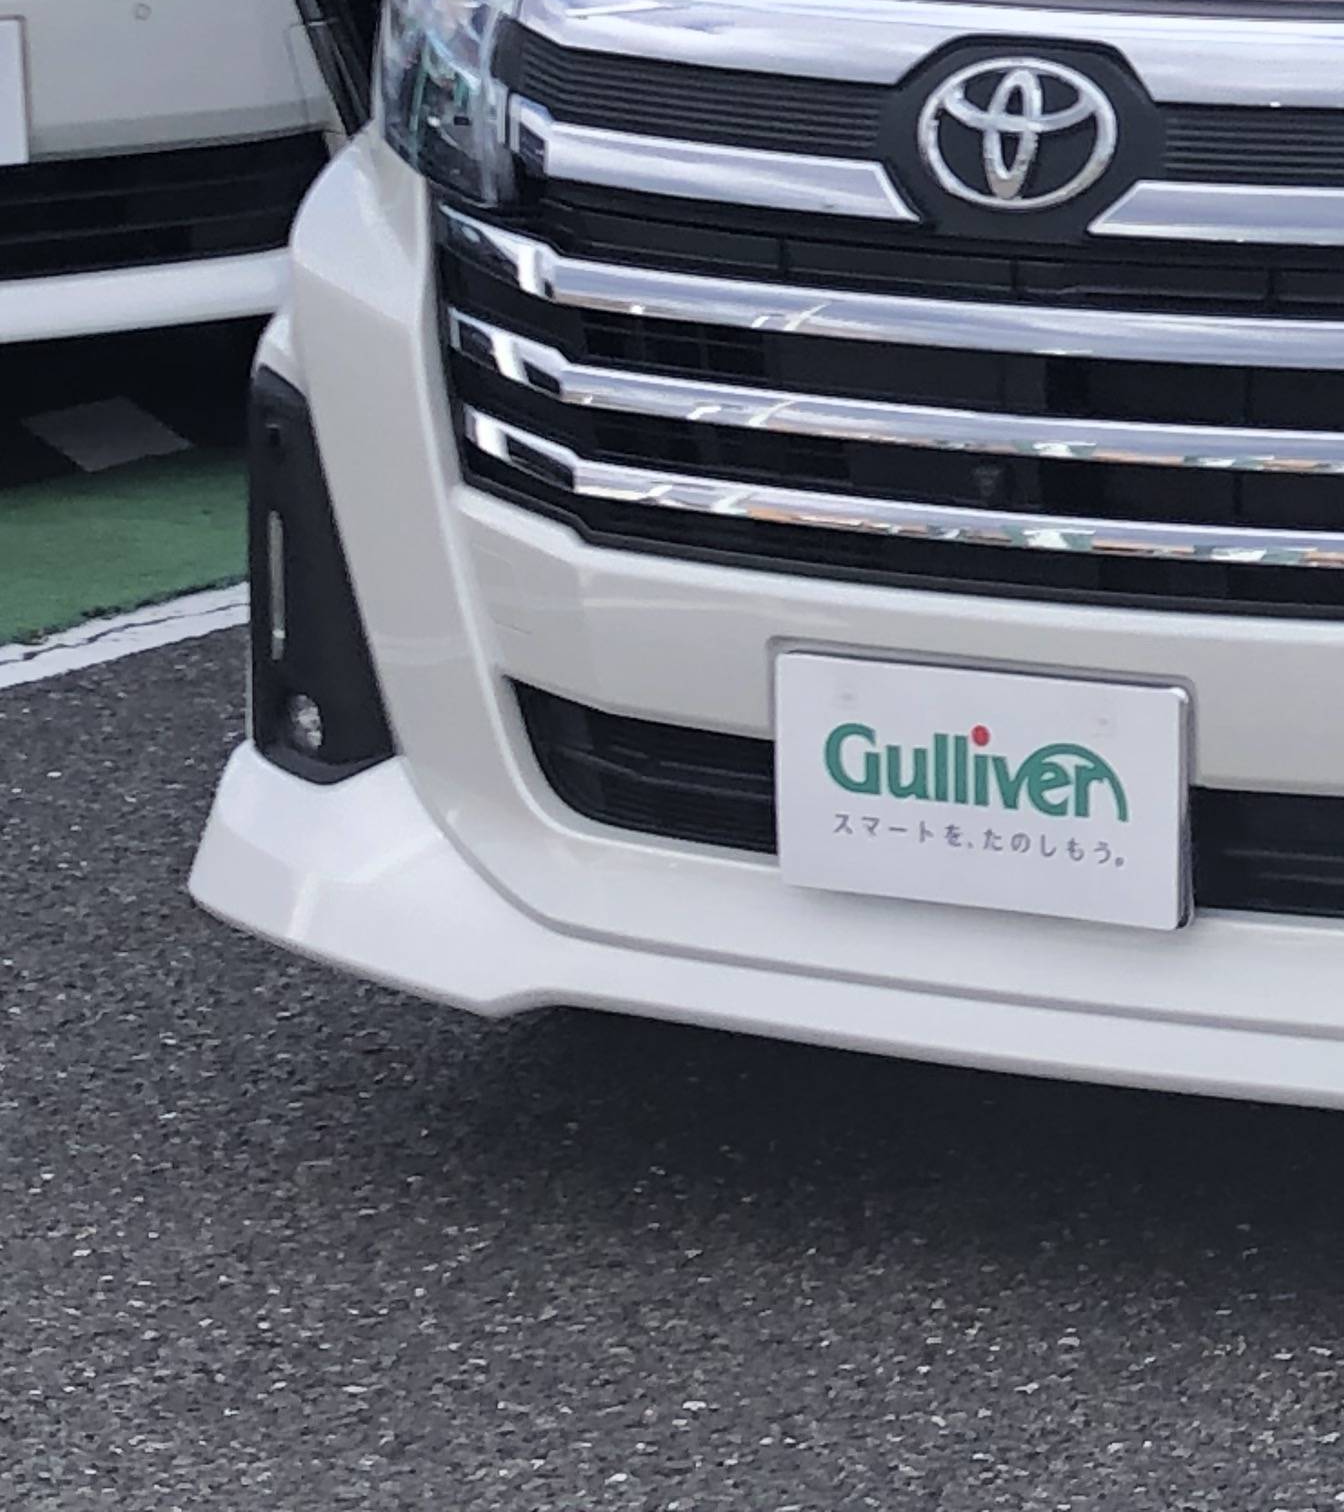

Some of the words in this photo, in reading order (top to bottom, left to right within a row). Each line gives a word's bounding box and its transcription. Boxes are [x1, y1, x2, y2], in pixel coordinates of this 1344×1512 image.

[824, 722, 1130, 823] Gulliver
[832, 812, 1126, 869] スマートを、たのしもう。
